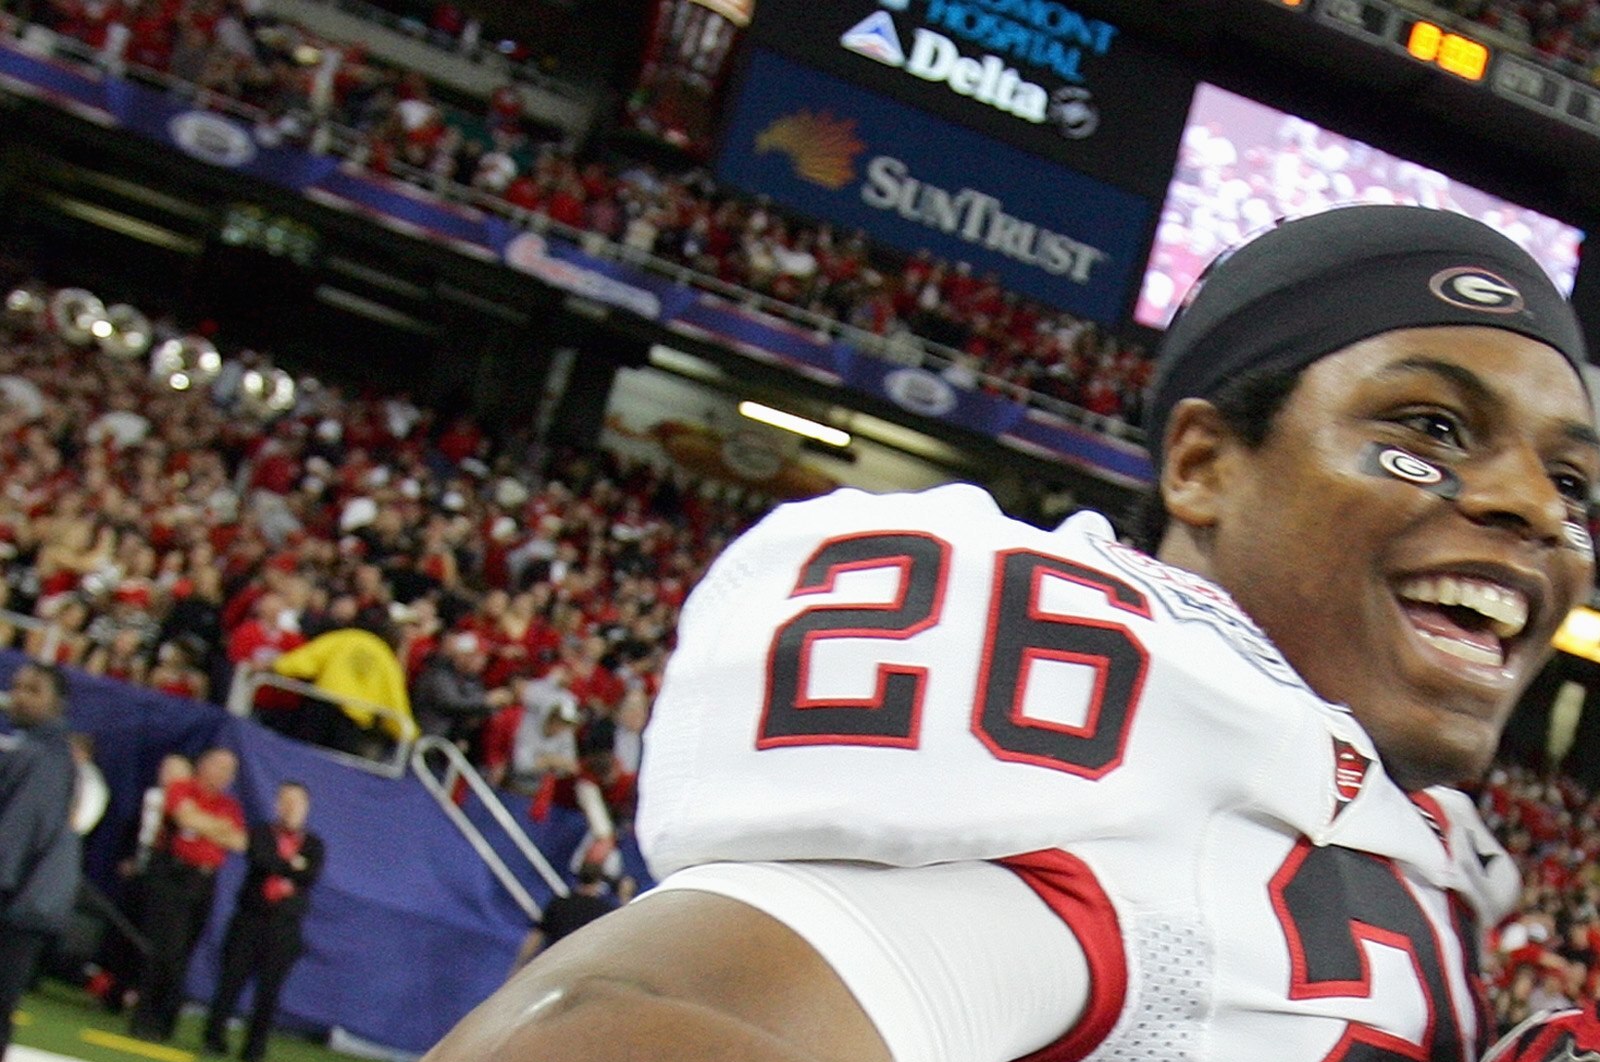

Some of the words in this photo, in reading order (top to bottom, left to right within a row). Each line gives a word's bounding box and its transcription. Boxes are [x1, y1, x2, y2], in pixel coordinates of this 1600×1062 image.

[906, 27, 1049, 124] Delta
[1450, 272, 1522, 307] G
[755, 529, 1154, 781] 26
